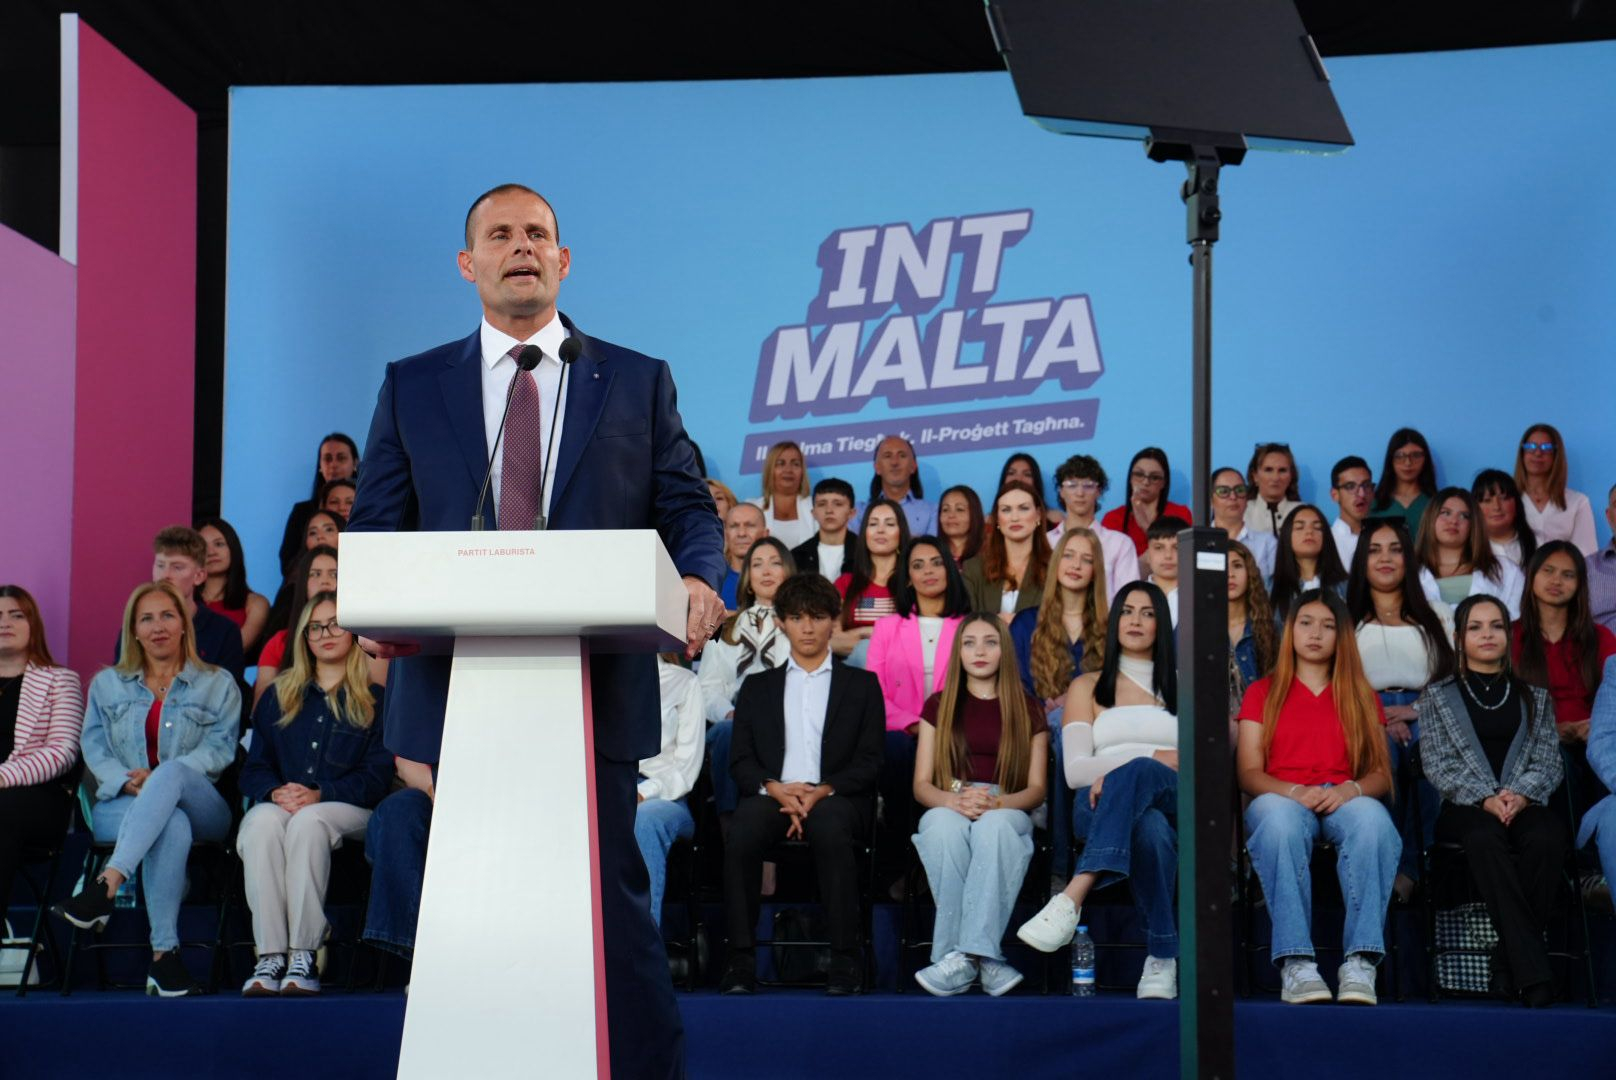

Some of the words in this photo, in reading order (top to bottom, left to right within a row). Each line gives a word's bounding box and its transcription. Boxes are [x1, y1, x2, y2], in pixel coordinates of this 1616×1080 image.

[828, 211, 1030, 308] INT
[766, 297, 1101, 406] MALTA
[921, 422, 1009, 443] Il-Proġett
[1013, 416, 1085, 435] Tagħna.
[457, 549, 488, 557] PARTIT
[489, 548, 535, 556] LABURISTA
